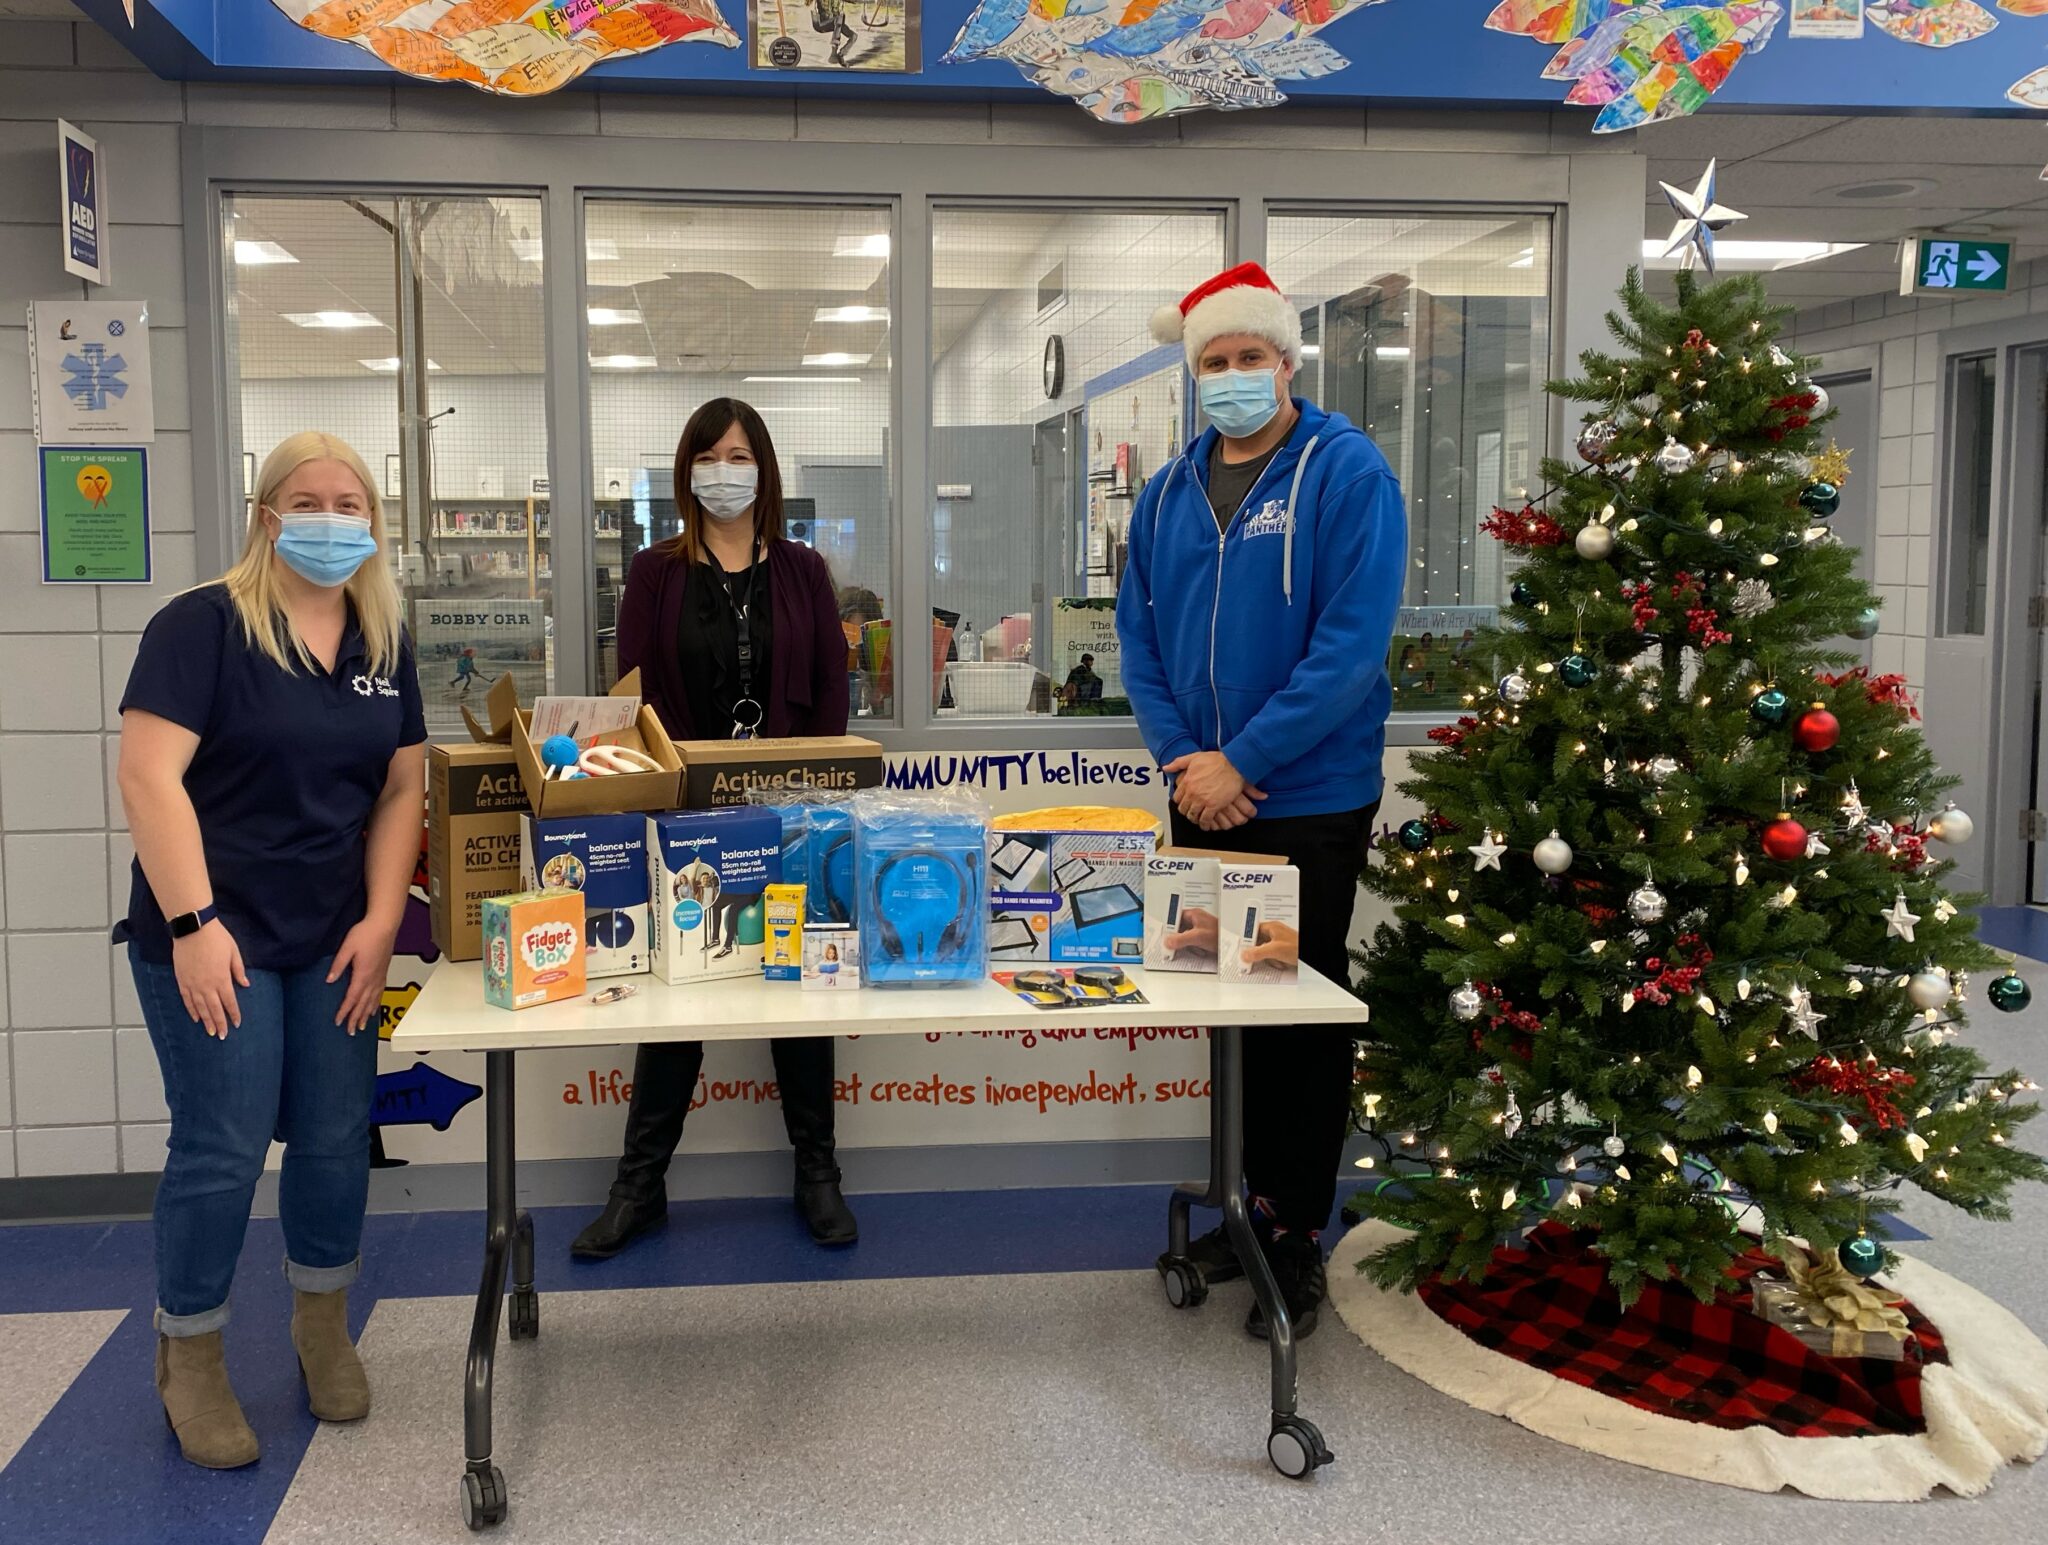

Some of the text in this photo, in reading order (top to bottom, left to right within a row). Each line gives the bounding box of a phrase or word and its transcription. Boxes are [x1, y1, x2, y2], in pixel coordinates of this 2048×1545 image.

[71, 200, 95, 231] AED
[1245, 521, 1297, 538] PANTHER
[430, 614, 530, 625] BOBBY ORR
[1090, 620, 1111, 631] The
[1401, 611, 1492, 629] When We Are Kind
[1096, 631, 1115, 640] with
[1067, 640, 1120, 653] Scraggly
[1038, 751, 1151, 787] believes
[712, 766, 857, 793] ActiveChairs
[476, 796, 528, 807] let active
[712, 794, 726, 805] let
[464, 834, 521, 851] ACTIVE
[544, 831, 587, 842] Bouncyband
[670, 836, 718, 848] Bouncyband
[588, 840, 641, 853] balance ball
[1117, 838, 1146, 850] 2.5x
[465, 852, 492, 867] KID
[721, 846, 779, 860] balance ball
[589, 859, 617, 867] weighted
[740, 859, 762, 867] no-roll
[721, 866, 752, 875] weighted
[465, 889, 513, 900] FEATURES
[654, 857, 662, 952] Bouncyband
[526, 929, 572, 953] Fidget
[497, 941, 506, 973] Fidget
[562, 1083, 583, 1105] a
[588, 1069, 633, 1106] life
[697, 1072, 782, 1109] journe
[870, 1072, 976, 1106] creates
